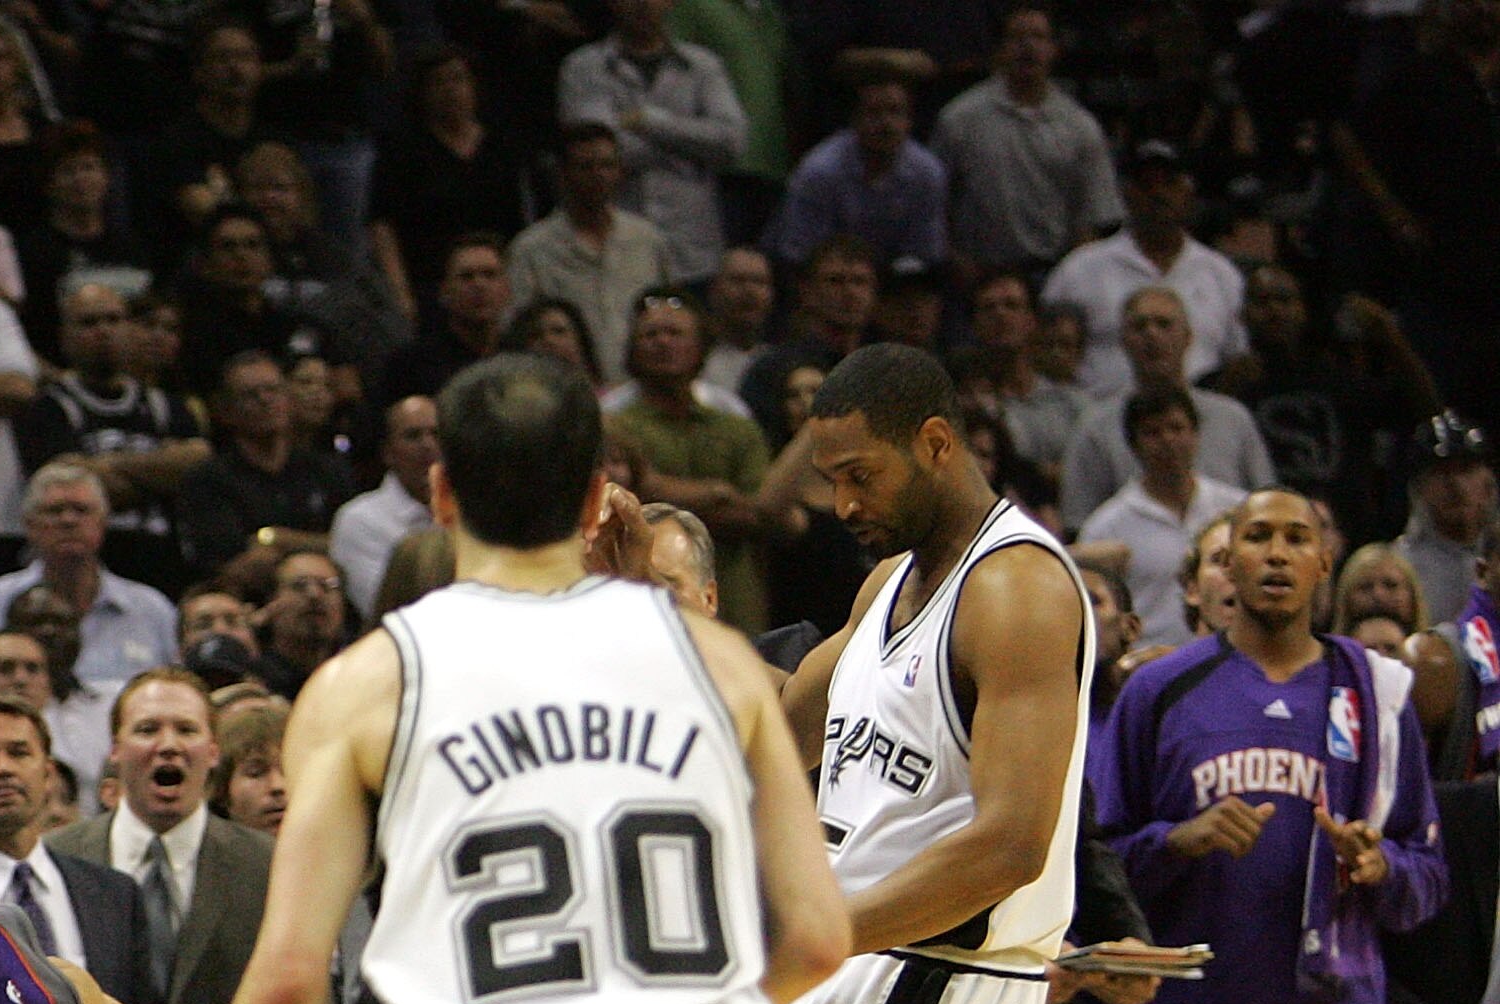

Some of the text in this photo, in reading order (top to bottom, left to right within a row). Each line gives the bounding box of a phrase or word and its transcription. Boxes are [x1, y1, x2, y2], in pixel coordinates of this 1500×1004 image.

[438, 704, 699, 795] GINOBILI
[825, 714, 937, 798] PURS
[1191, 747, 1323, 811] PHOEN
